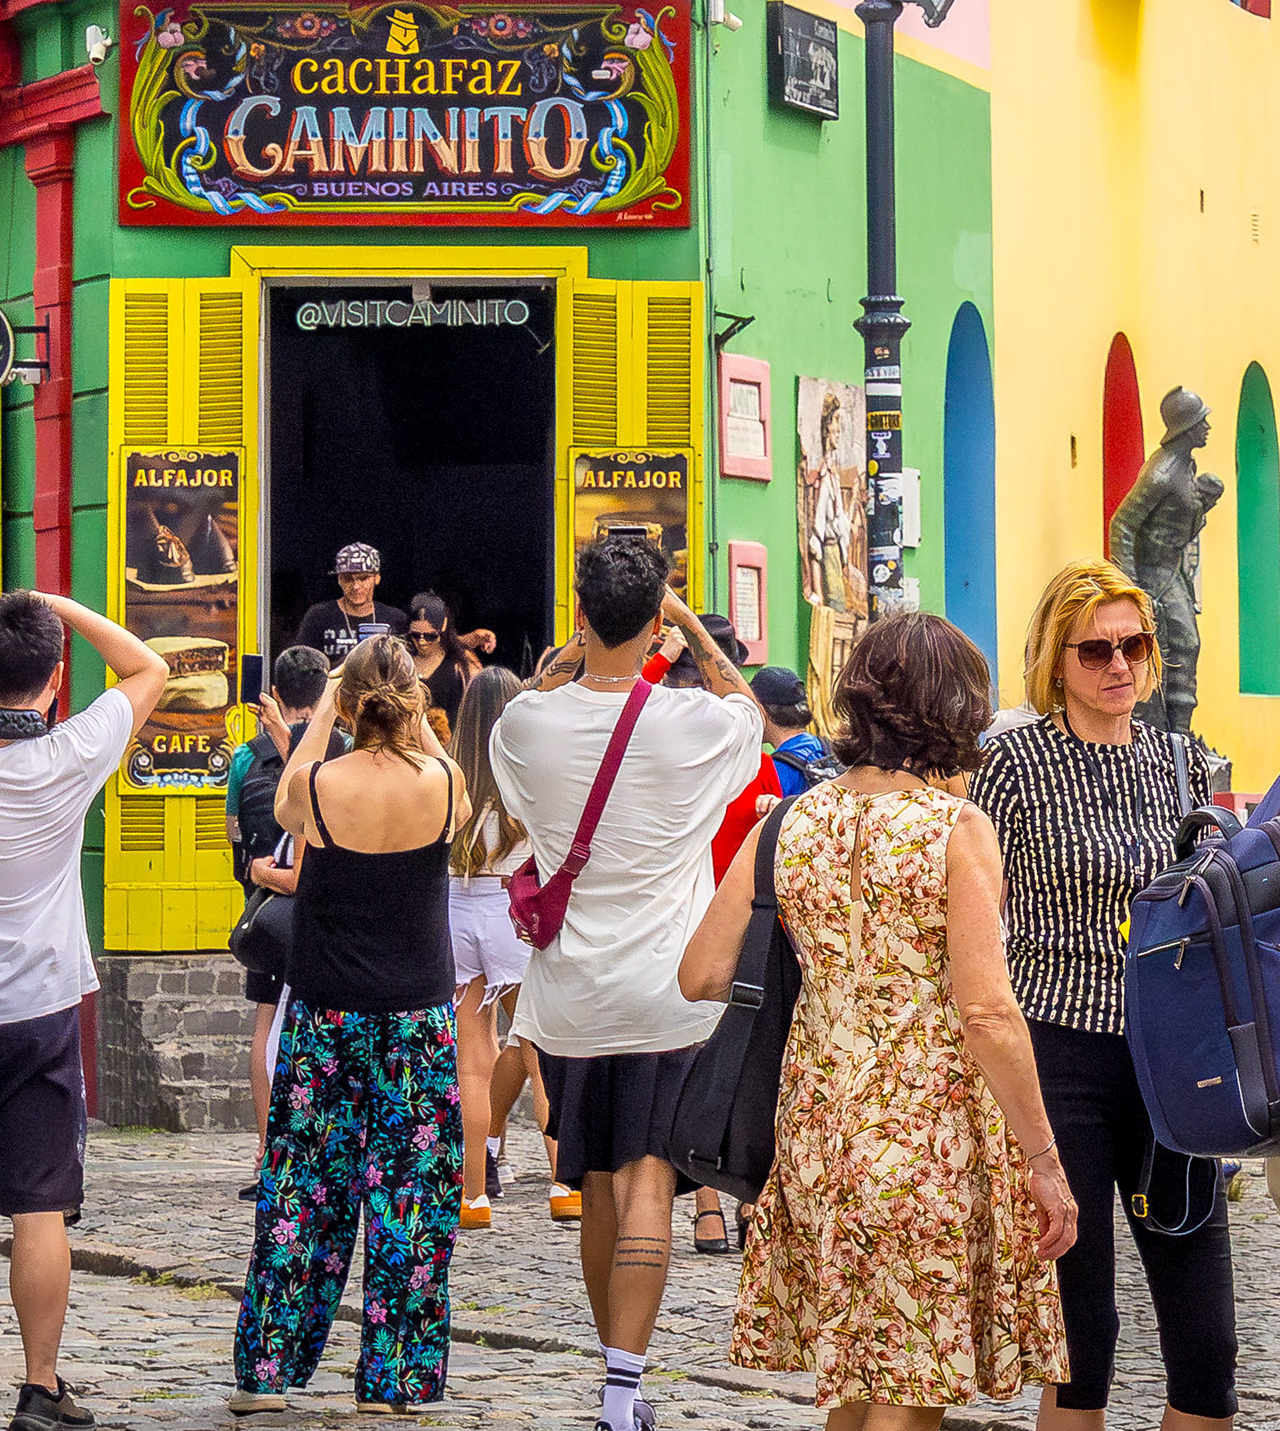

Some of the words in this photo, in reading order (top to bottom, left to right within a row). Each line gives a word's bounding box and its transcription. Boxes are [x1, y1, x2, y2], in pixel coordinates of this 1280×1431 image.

[222, 95, 589, 179] CAMINITO
[311, 181, 414, 197] BUENOS
[422, 181, 498, 197] AIRES
[296, 299, 530, 330] @VISITCAMINITO
[133, 469, 234, 488] ALFAJOR
[583, 470, 682, 489] ALFAJOR
[152, 734, 211, 754] CAFE
